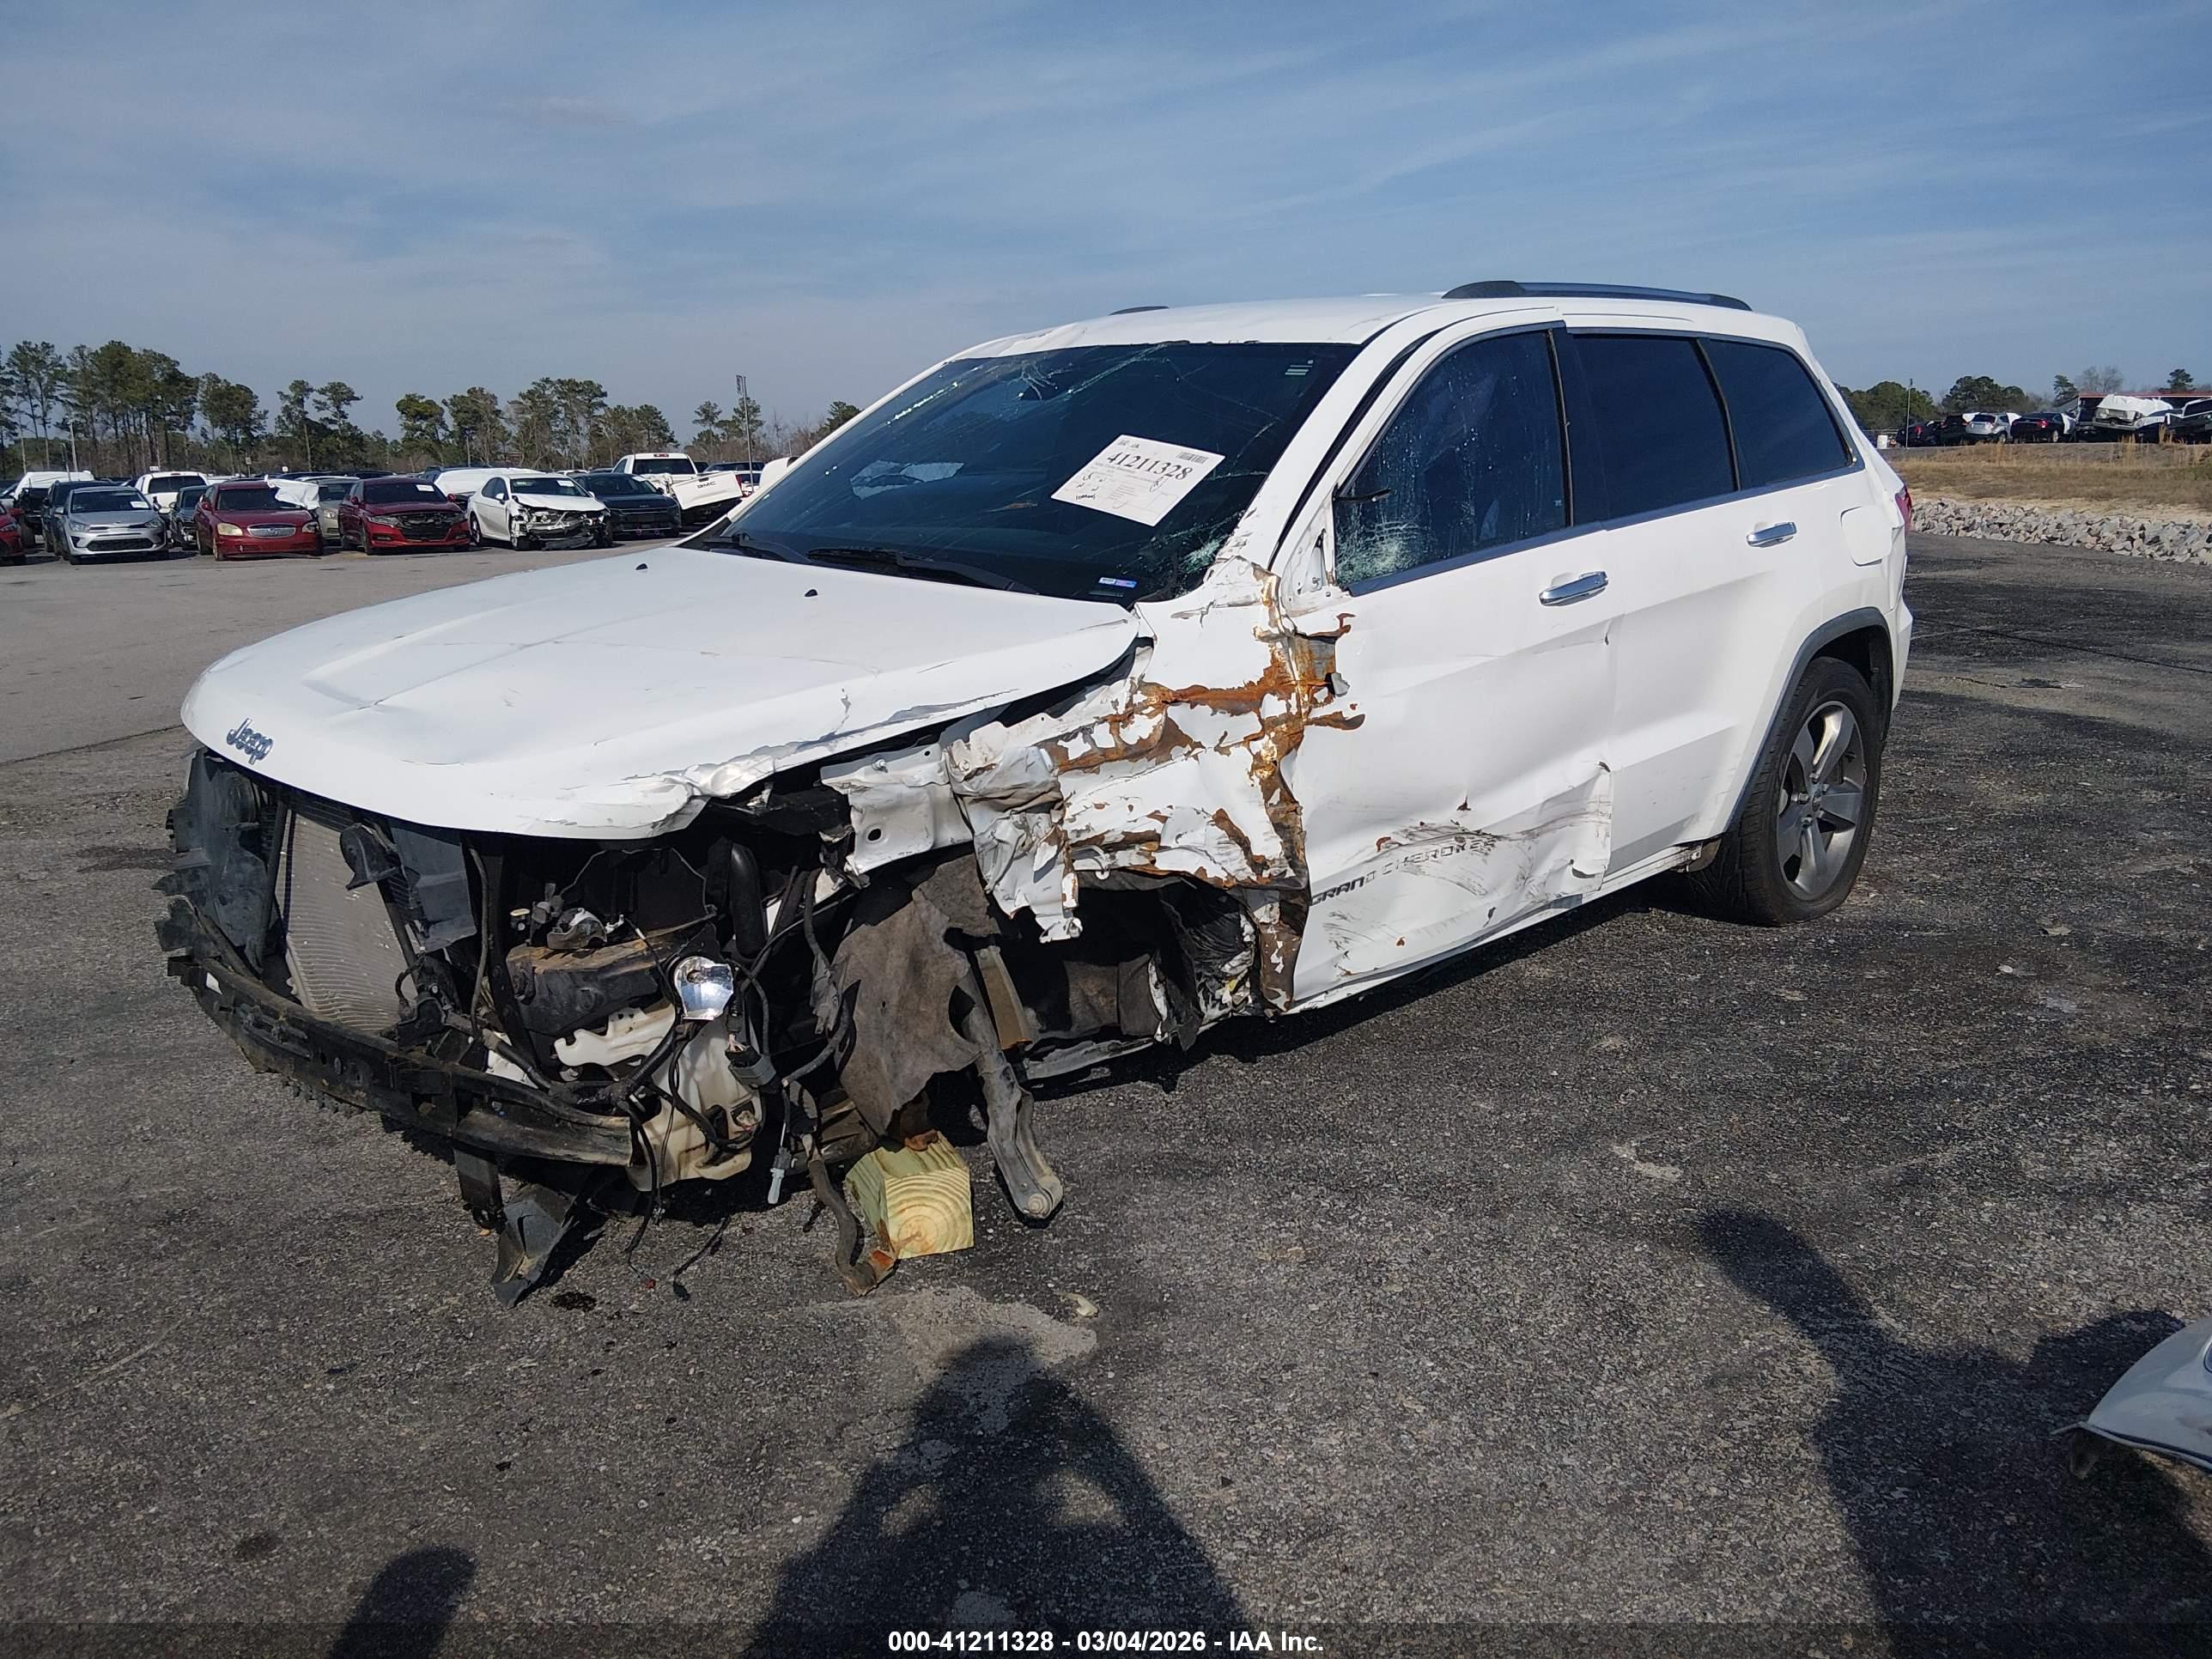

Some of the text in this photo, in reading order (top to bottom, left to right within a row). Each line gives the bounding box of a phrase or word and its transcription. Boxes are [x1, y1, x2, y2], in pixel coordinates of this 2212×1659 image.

[1107, 452, 1194, 481] 41211328
[226, 717, 274, 766] Jeep
[1310, 870, 1376, 906] GRAND
